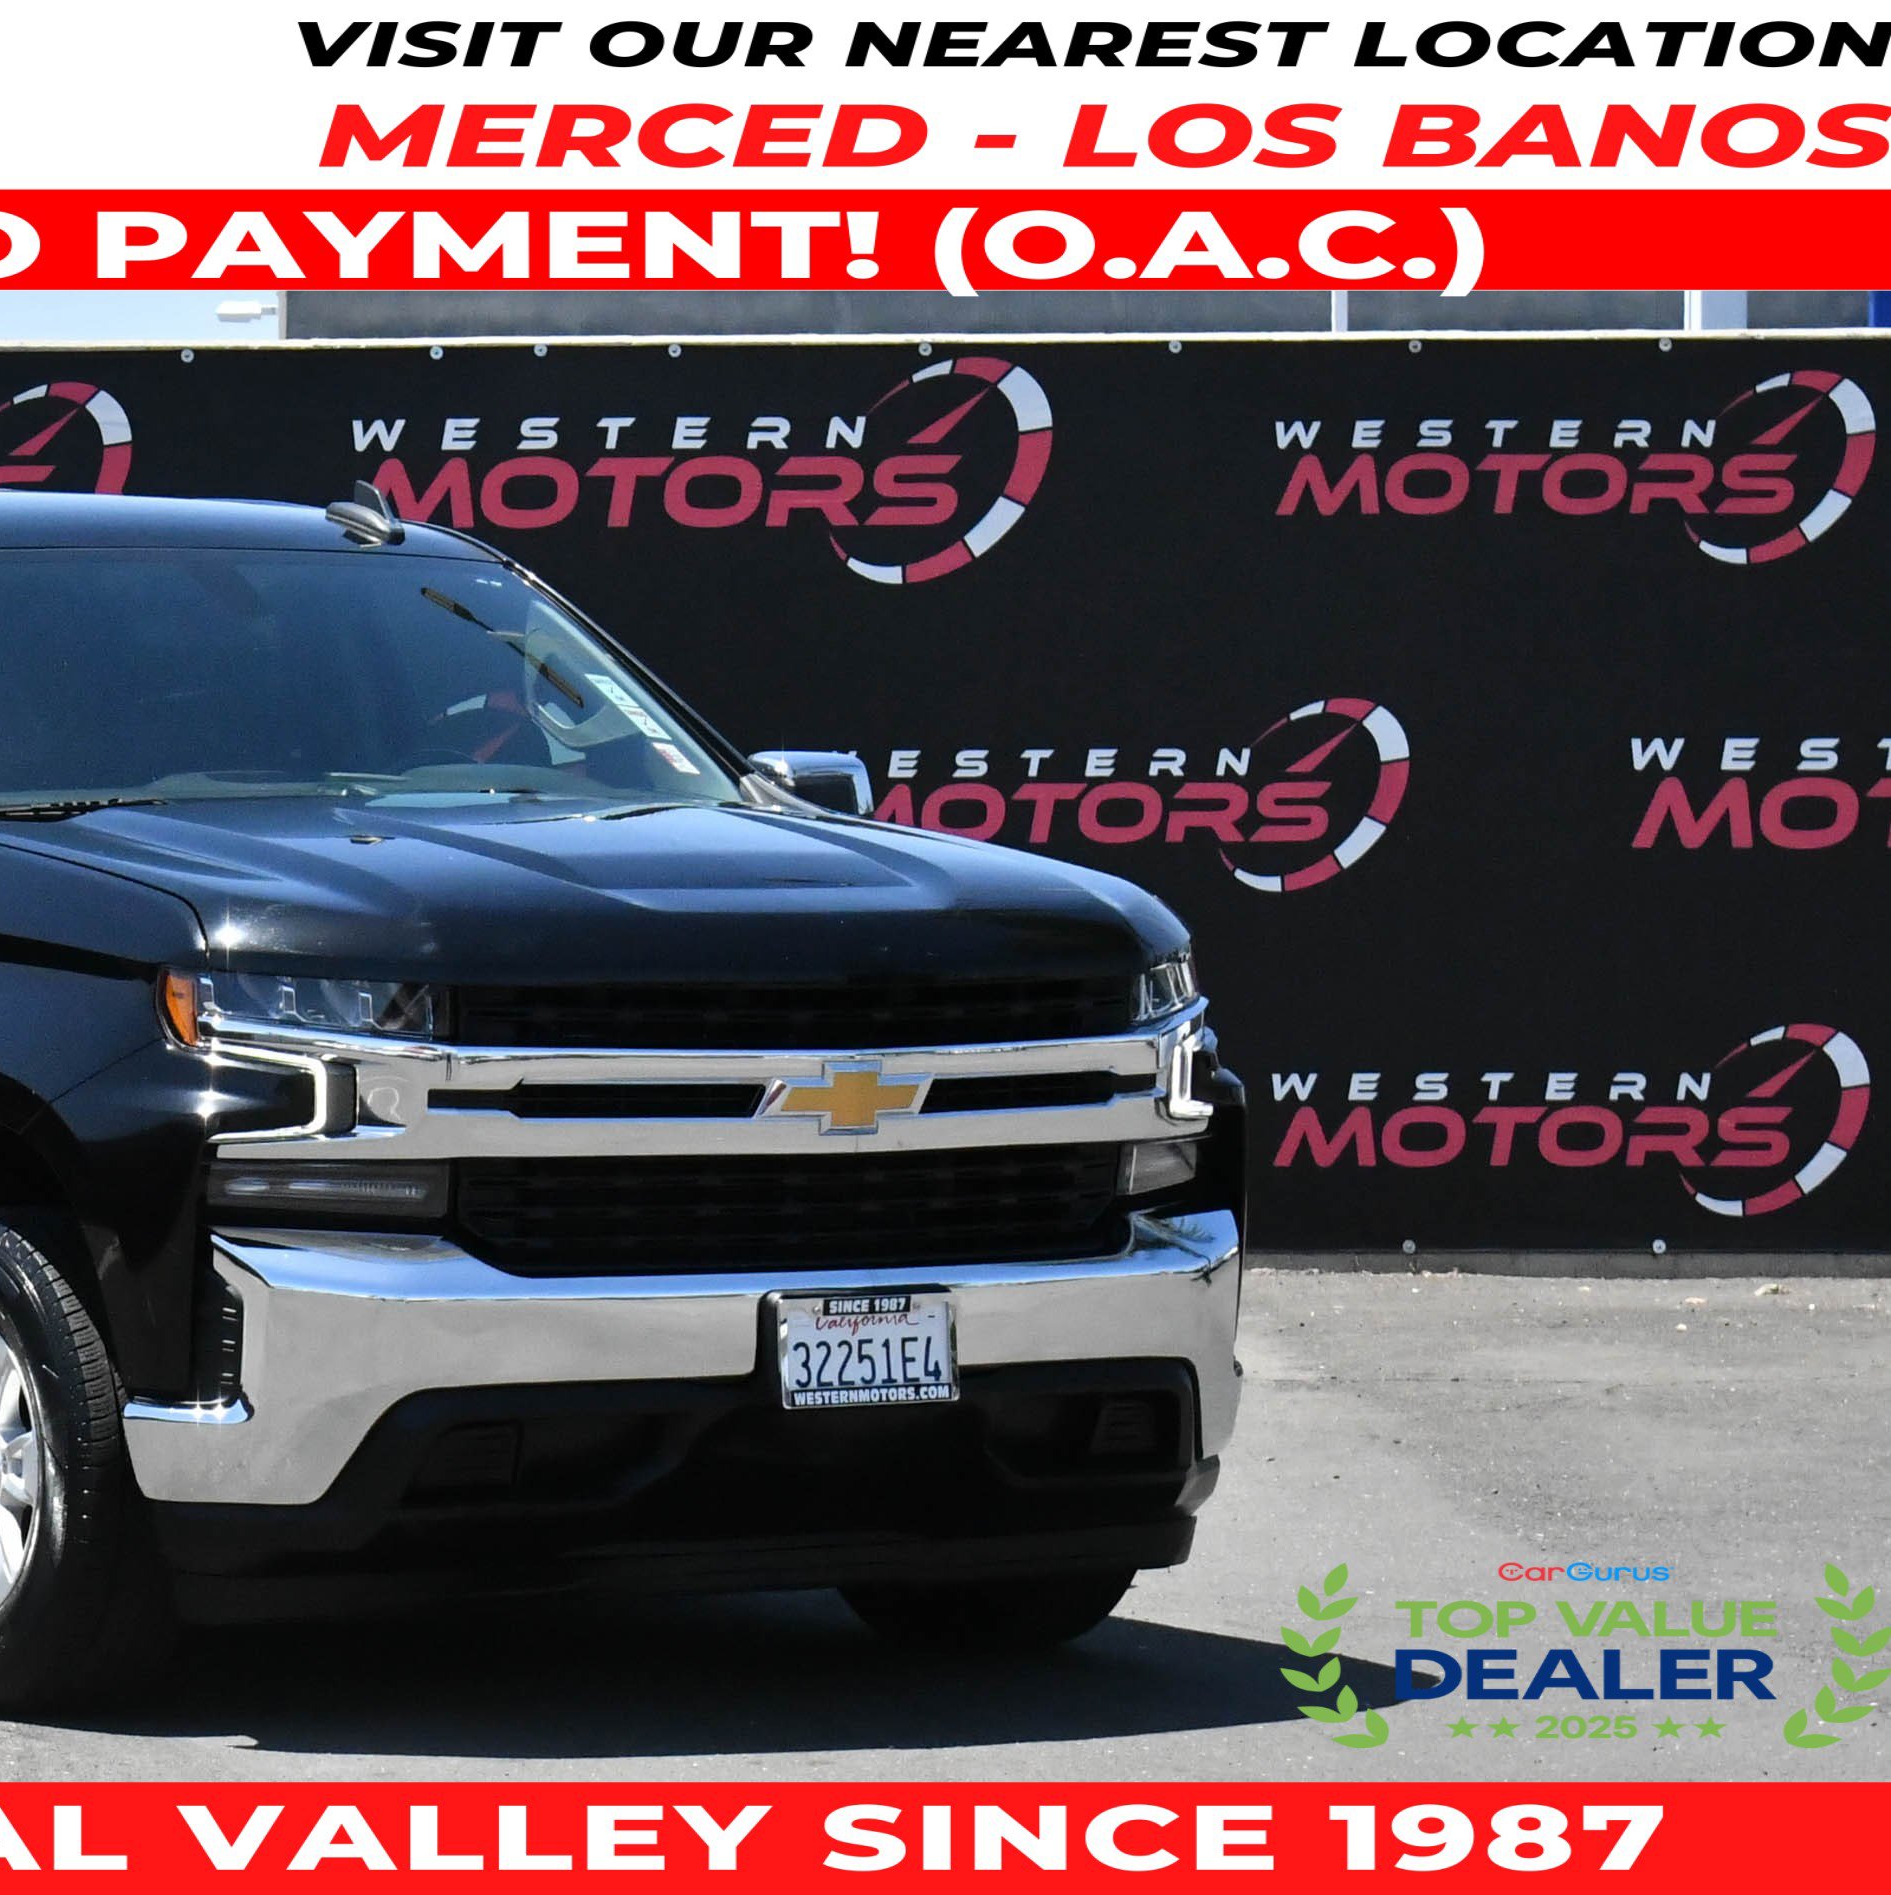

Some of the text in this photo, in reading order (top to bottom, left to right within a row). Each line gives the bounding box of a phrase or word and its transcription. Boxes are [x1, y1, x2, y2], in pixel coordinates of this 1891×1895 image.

[352, 415, 866, 452] WESTERN
[1275, 419, 1716, 450] WESTERN
[373, 455, 962, 529] MOTORS
[1275, 453, 1797, 516] MOTORS
[887, 748, 1251, 778] ESTERN
[1271, 1072, 1711, 1101] WESTERN
[1273, 1106, 1791, 1167] MOTORS
[829, 1297, 906, 1314] SINCE 1987
[792, 1336, 943, 1388] 32251E4
[793, 1384, 950, 1406] WESTERNMOTORS.COM
